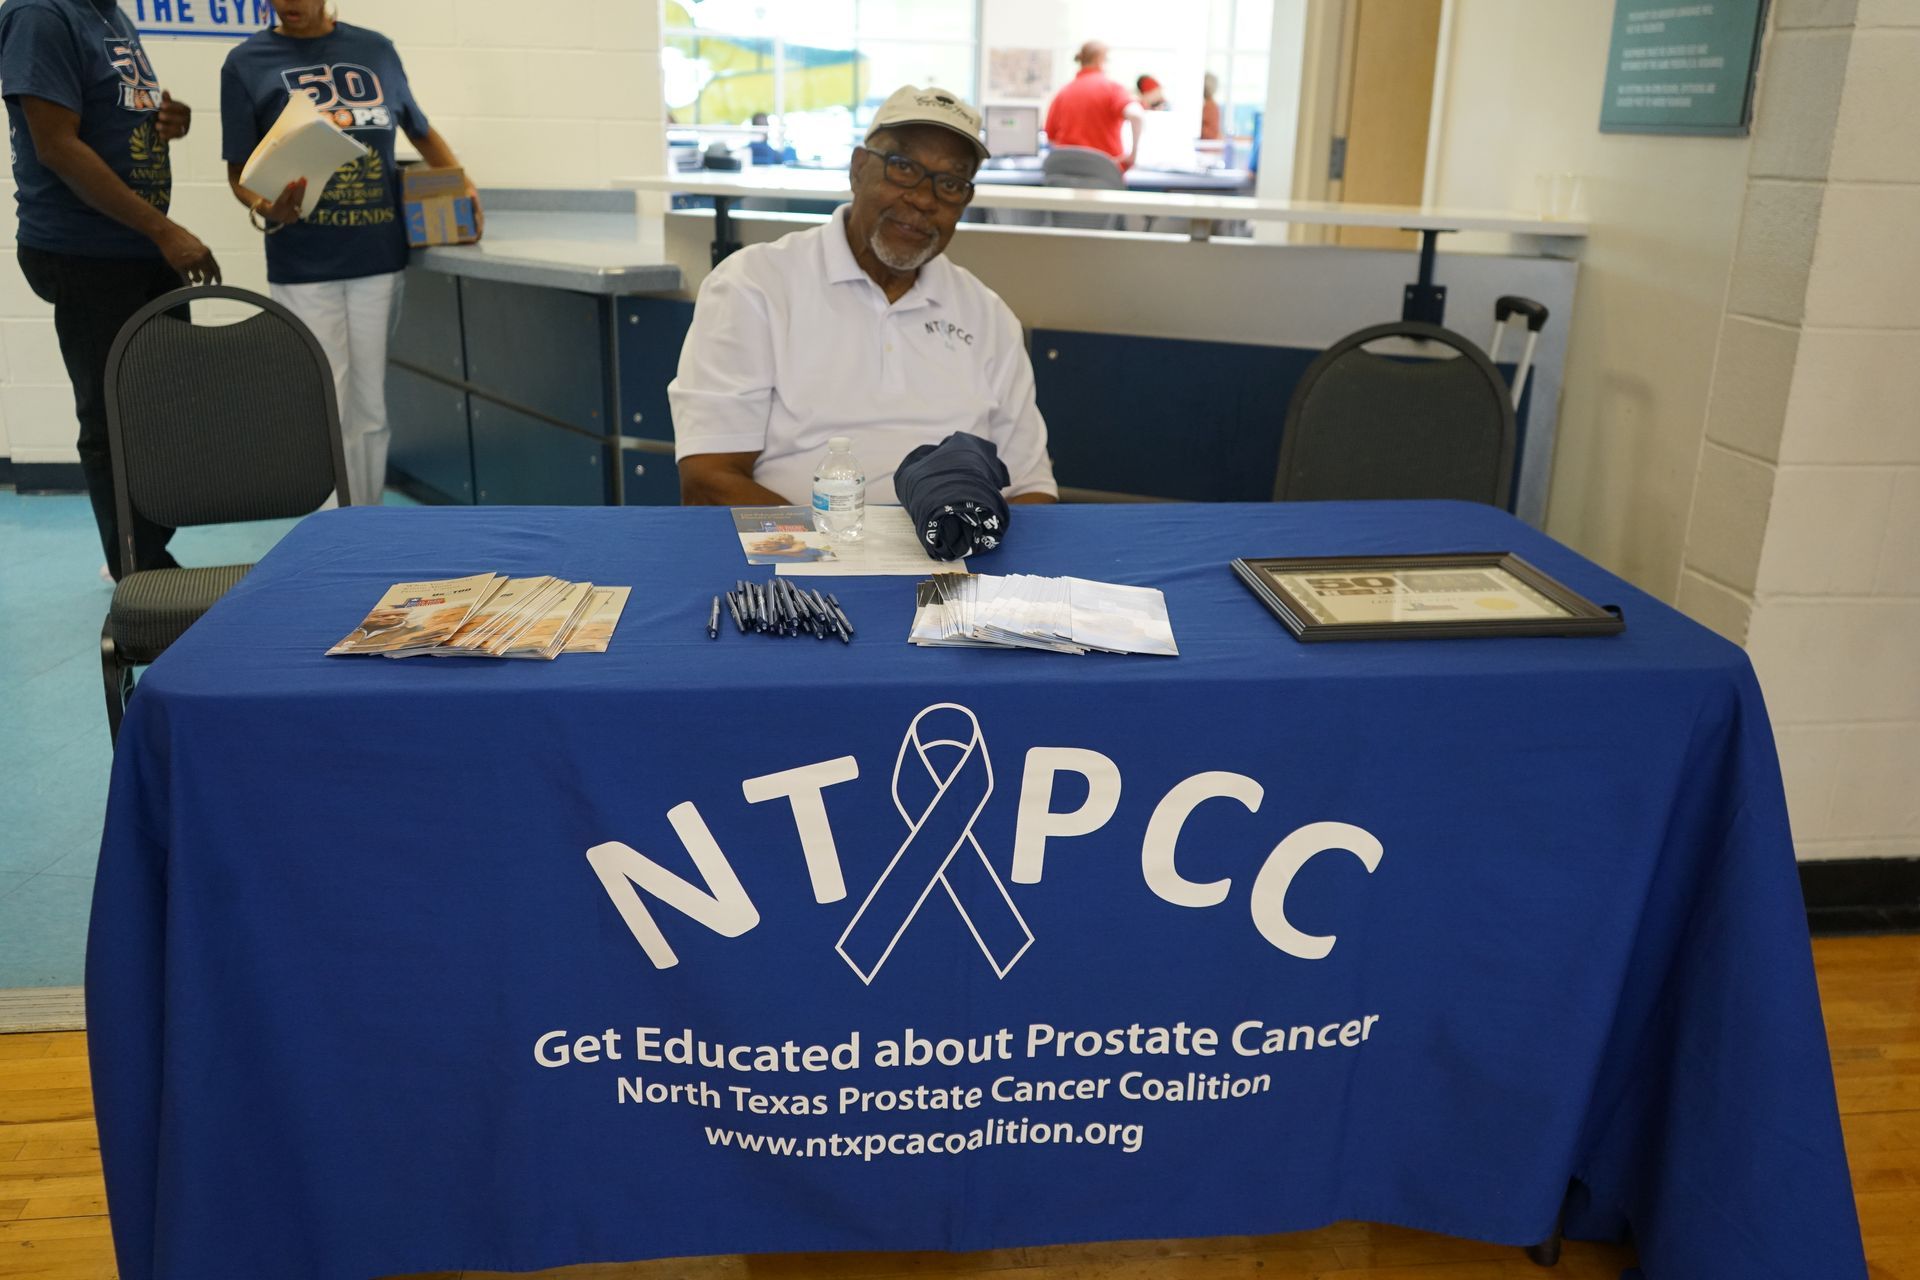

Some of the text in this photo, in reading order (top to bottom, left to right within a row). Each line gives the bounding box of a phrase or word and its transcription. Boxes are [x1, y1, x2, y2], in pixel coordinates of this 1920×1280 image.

[136, 0, 195, 22] THE
[280, 62, 385, 110] 50
[1305, 576, 1396, 589] 50
[534, 1015, 1379, 1072] Get Educated about Prostate Cancer
[618, 1072, 1270, 1115] North Texas Prostate Cancer Coalition
[705, 1118, 1144, 1161] www.ntxpcacoalition.org
